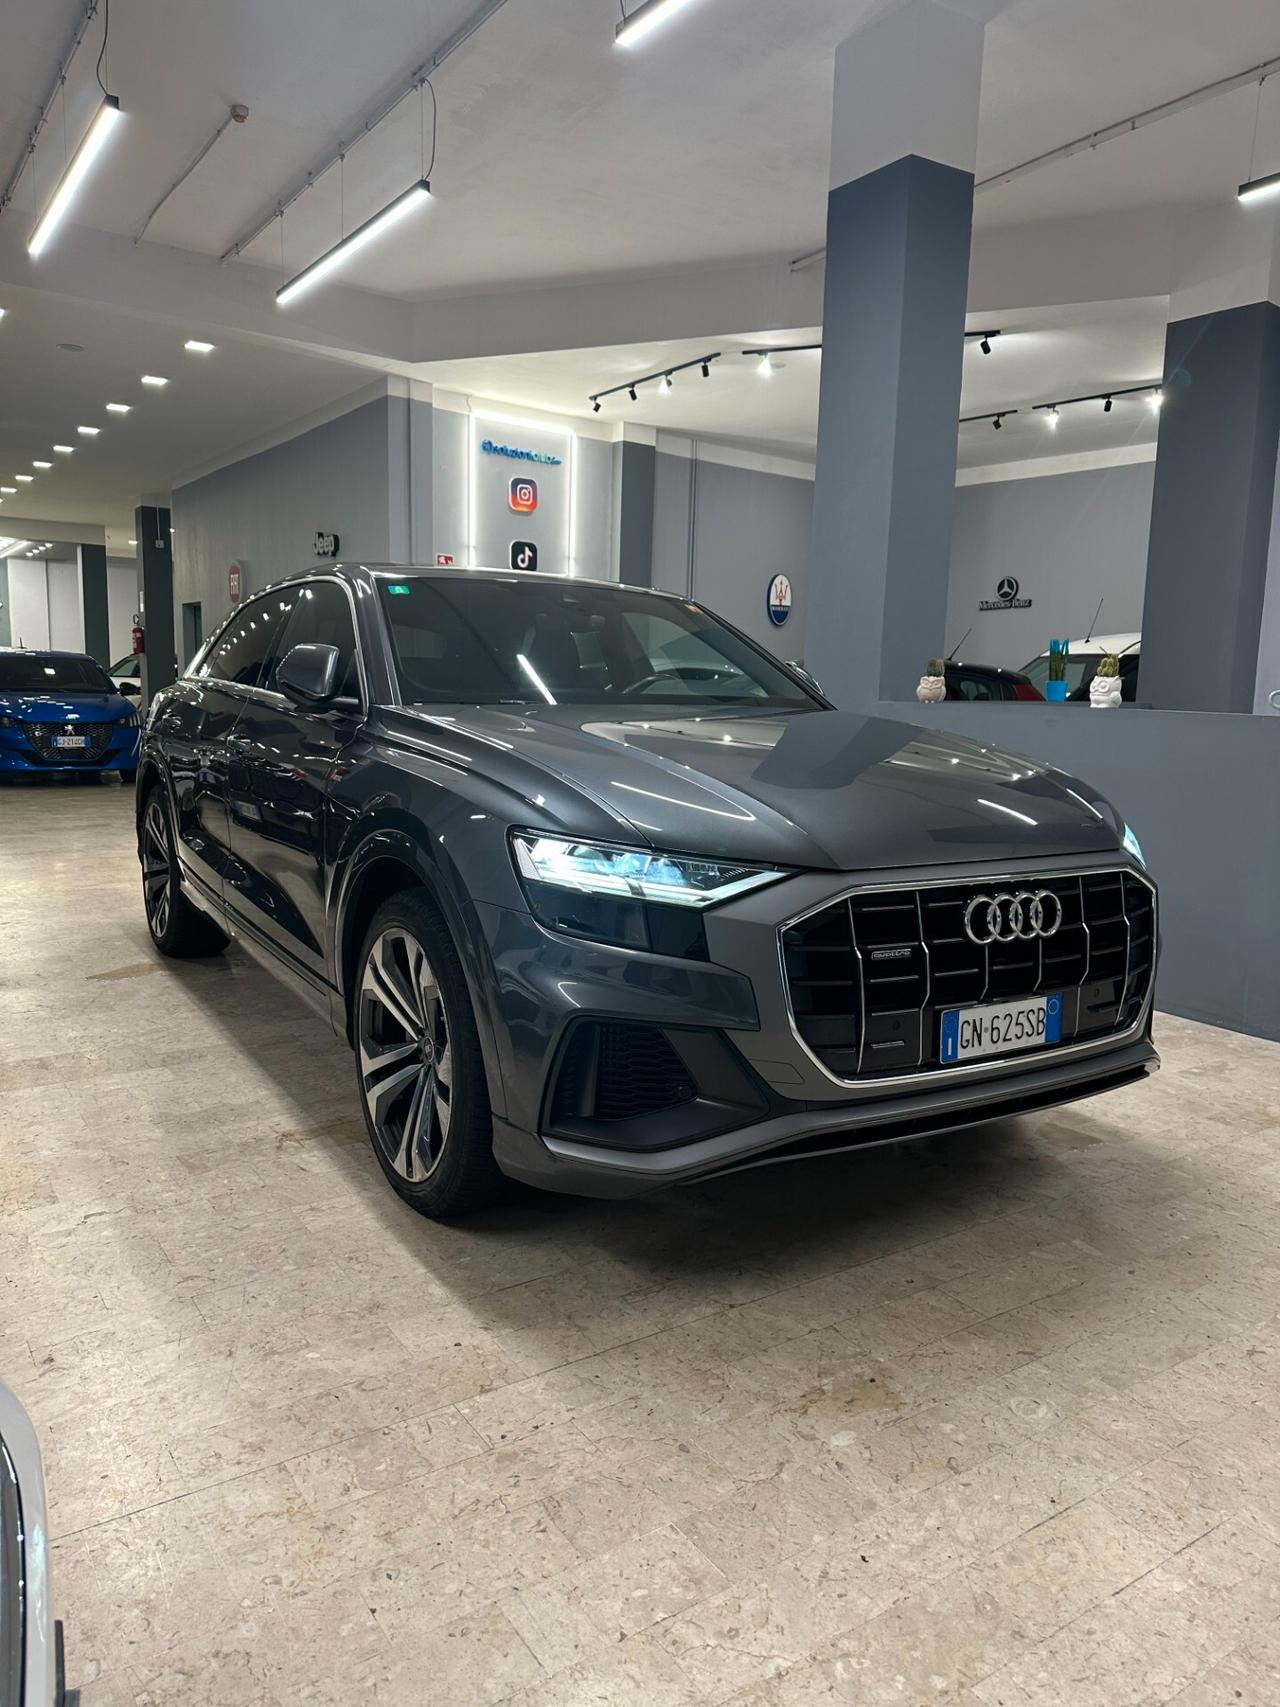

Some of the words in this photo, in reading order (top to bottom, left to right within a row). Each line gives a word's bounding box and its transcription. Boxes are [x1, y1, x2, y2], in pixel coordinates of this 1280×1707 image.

[313, 531, 339, 557] Jeep
[960, 1017, 983, 1049] GN
[990, 1007, 1046, 1044] 625SB
